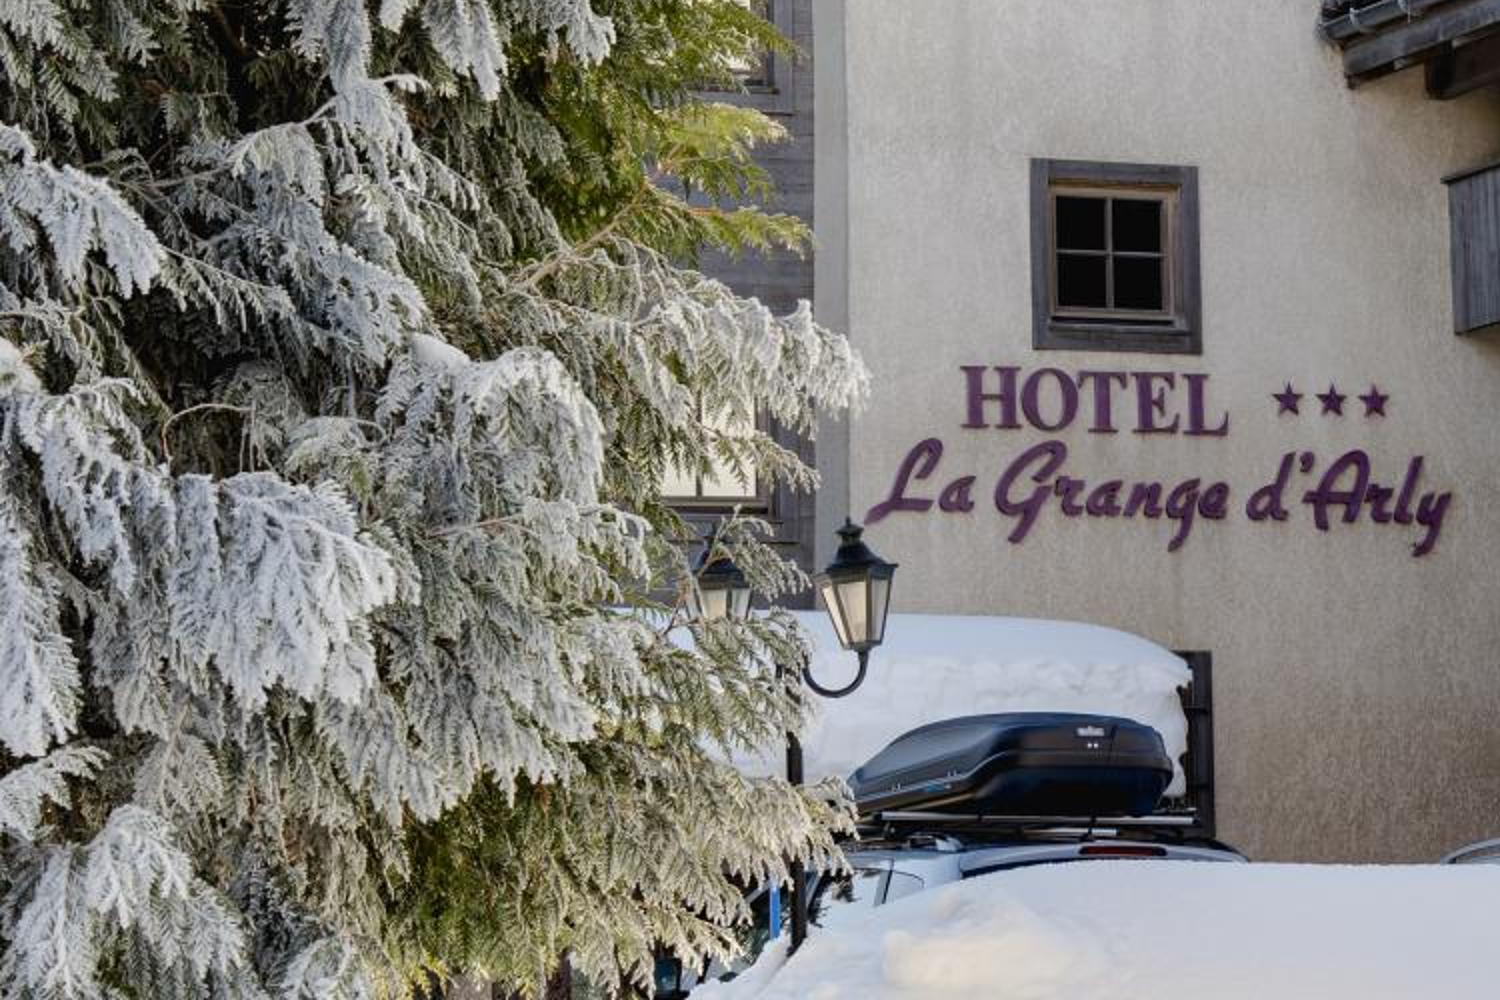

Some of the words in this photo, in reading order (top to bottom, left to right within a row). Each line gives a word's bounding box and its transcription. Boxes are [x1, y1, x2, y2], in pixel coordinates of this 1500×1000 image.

[959, 365, 1229, 437] HOTEL
[864, 438, 976, 525] La
[994, 440, 1230, 552] Grange
[1246, 449, 1453, 557] d'Arly
